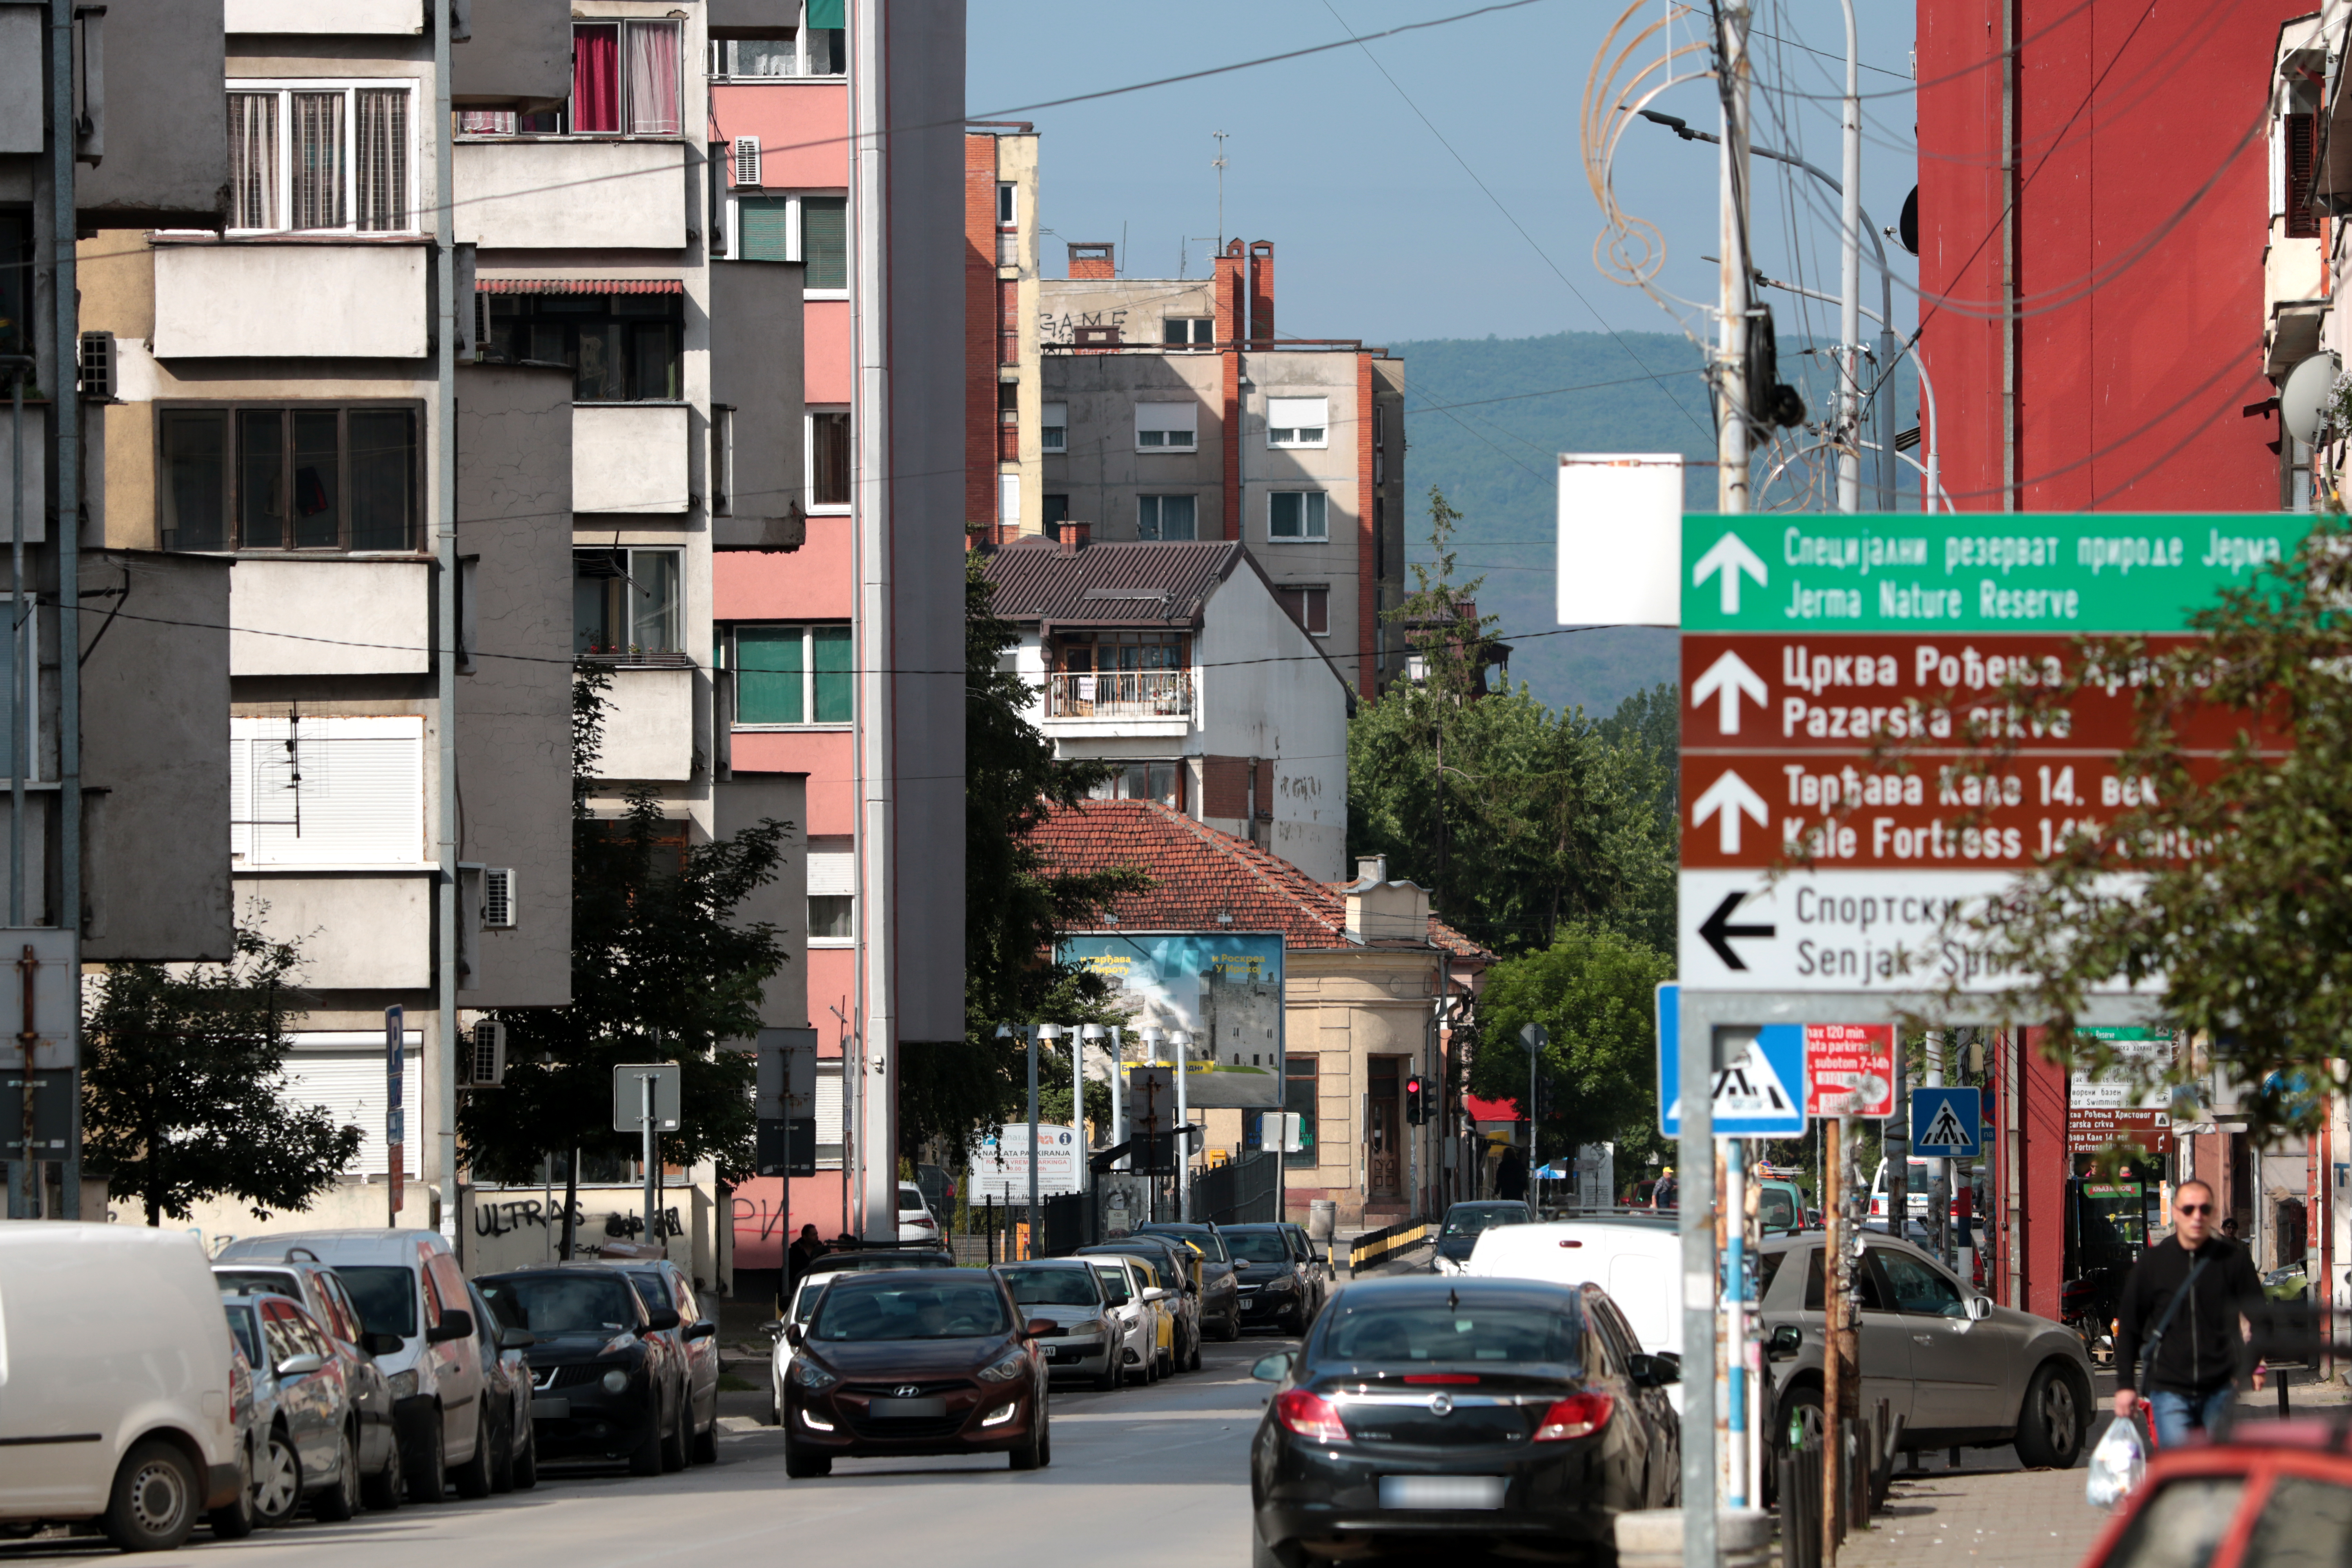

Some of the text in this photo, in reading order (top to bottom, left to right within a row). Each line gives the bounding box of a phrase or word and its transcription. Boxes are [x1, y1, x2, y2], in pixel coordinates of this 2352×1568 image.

[1784, 526, 1927, 576] Специјални
[1945, 536, 2060, 576] резерват
[2077, 536, 2184, 576] природе
[2201, 527, 2281, 576] Јерма
[1784, 579, 2078, 619] Jerma Nature Reserve
[1783, 645, 1898, 697] Црква
[1783, 697, 1951, 738] Pazarska
[1783, 765, 1923, 816] Тврђава
[1938, 765, 2022, 807] Кале
[2038, 765, 2085, 806] 14.
[1783, 817, 1857, 859] Kale
[1873, 817, 2022, 859] Fortress
[1797, 887, 1960, 933] Спортски
[1221, 954, 1265, 964] Роскреа
[1797, 940, 1913, 986] Senjak
[1091, 965, 1129, 975] Пироту
[1216, 964, 1261, 975] У Ирској
[1826, 1025, 1844, 1039] 120
[1845, 1026, 1867, 1039] min.
[2096, 1030, 2115, 1039] Reserve
[1828, 1040, 1882, 1056] parkiranj
[1815, 1056, 1889, 1070] subotom 7-14h
[2072, 1075, 2082, 1084] jak
[2087, 1099, 2121, 1107] Swimming
[2084, 1110, 2112, 1119] Рођења
[2115, 1110, 2151, 1120] Христовог
[2070, 1120, 2091, 1128] arska
[2070, 1132, 2085, 1142] ђава
[2087, 1133, 2103, 1141] Кале
